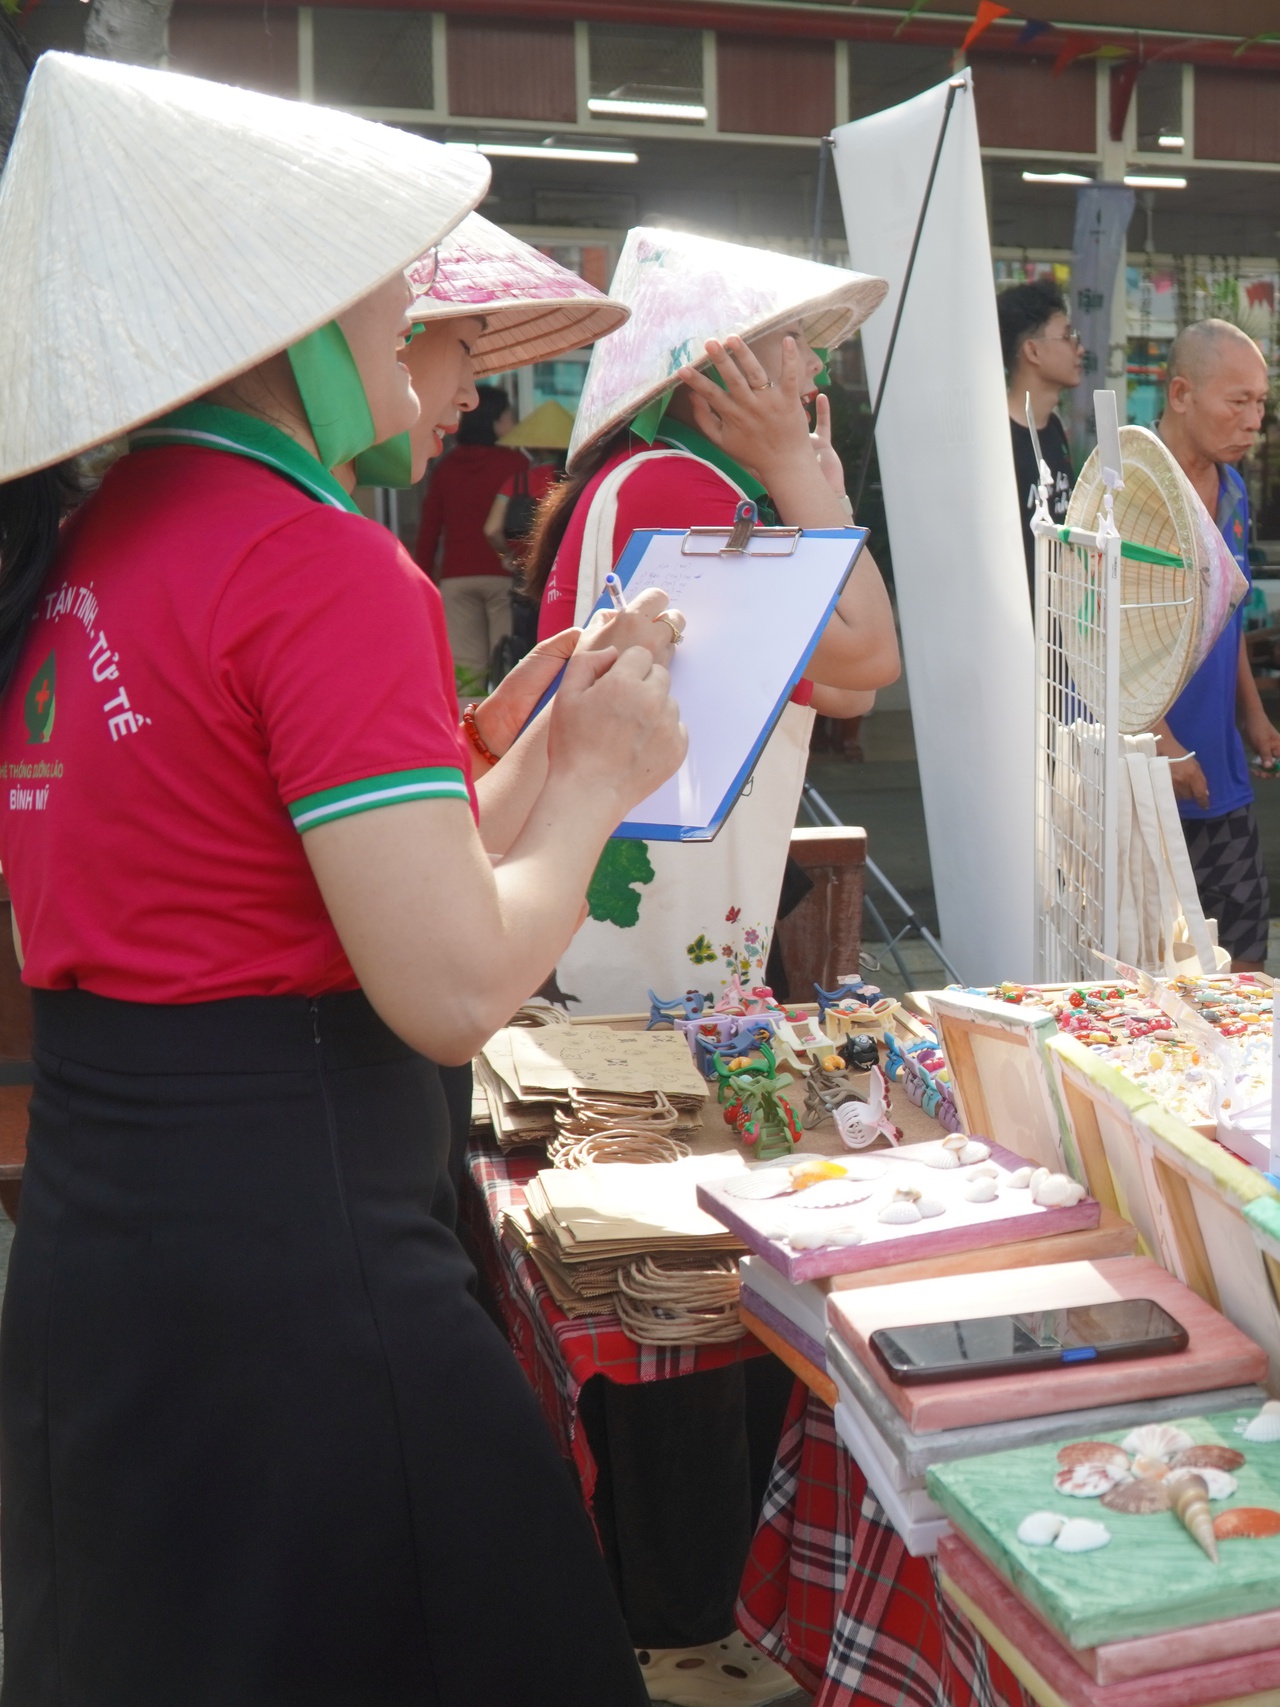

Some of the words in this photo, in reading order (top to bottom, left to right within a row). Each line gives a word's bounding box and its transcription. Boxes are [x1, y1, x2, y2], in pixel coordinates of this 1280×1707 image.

[45, 581, 77, 624] TẬN
[73, 581, 99, 633] TÌNH
[547, 575, 563, 604] TẾ
[88, 630, 120, 683] TỬ
[103, 685, 153, 742] TẾ
[10, 783, 34, 811] BÌNH
